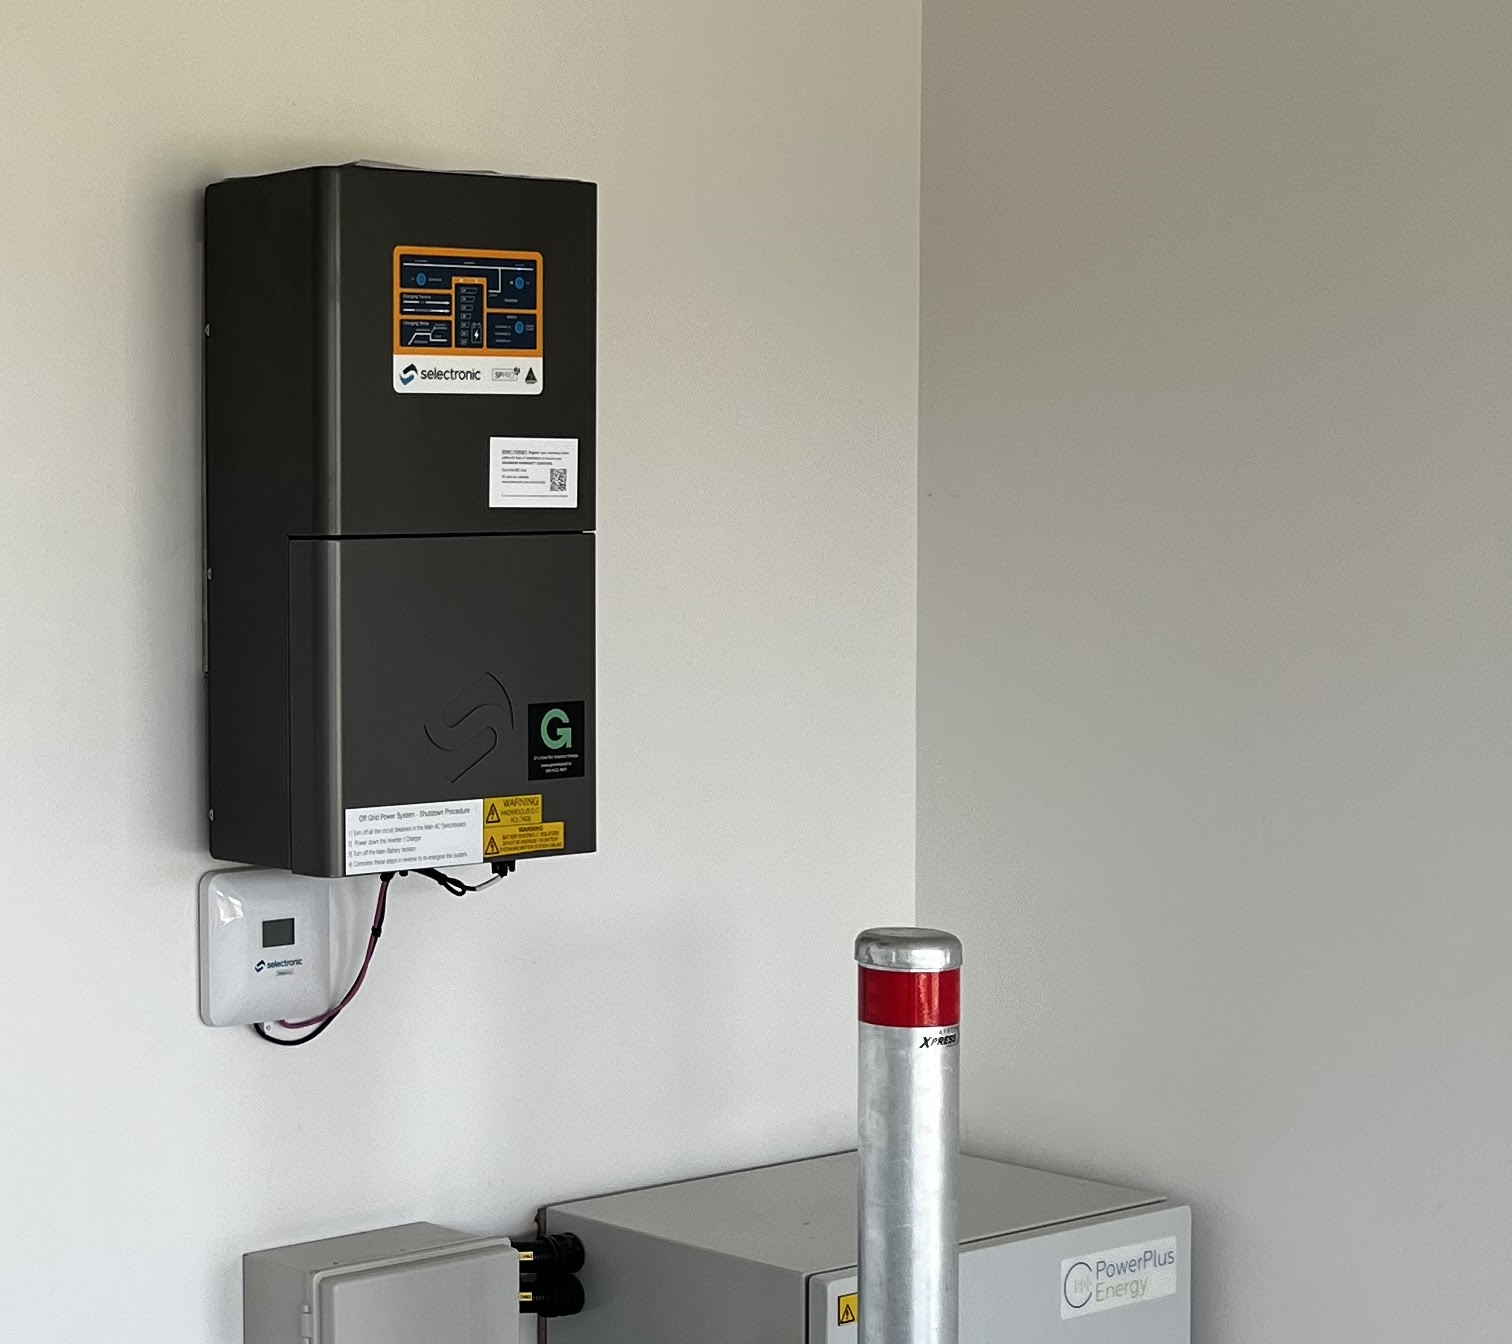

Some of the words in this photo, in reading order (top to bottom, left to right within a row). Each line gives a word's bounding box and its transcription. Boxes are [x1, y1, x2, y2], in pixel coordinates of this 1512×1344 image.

[420, 367, 481, 381] selectronic
[503, 797, 538, 807] WARNING
[397, 812, 415, 820] System
[420, 810, 444, 818] Shutdown
[267, 958, 303, 968] selectronic
[1095, 1248, 1175, 1280] PowerPlus
[1095, 1277, 1148, 1303] Energy
